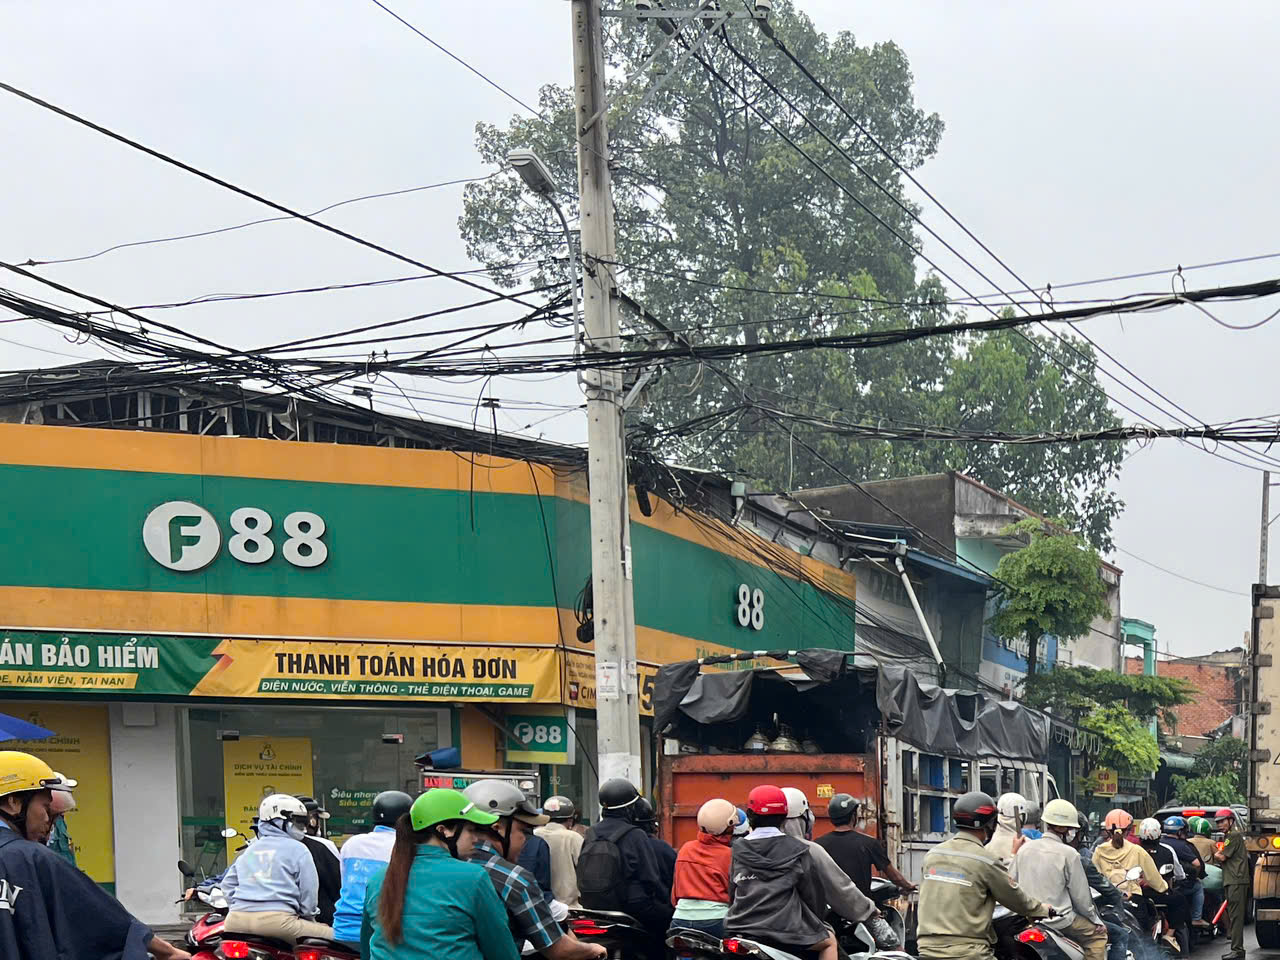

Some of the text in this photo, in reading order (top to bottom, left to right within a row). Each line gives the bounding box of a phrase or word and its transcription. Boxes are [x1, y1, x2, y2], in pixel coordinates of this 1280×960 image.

[143, 500, 328, 572] F88
[737, 583, 765, 631] 88
[42, 637, 90, 667] BẢO
[98, 637, 159, 668] HIỂM
[275, 651, 517, 679] THANH TOÁN HÓA ĐƠN
[81, 677, 98, 685] TAI
[262, 680, 288, 692] ĐIỆN
[291, 681, 327, 693] NƯỚC,
[331, 681, 355, 694] VIỄN
[359, 683, 399, 694] THÔNG
[408, 683, 430, 695] THẺ
[431, 685, 458, 697] ĐIỆN
[459, 686, 496, 698] THOẠI,
[498, 687, 530, 697] GAME
[581, 686, 596, 699] CIM
[513, 722, 562, 744] F88
[354, 791, 379, 799] nhan
